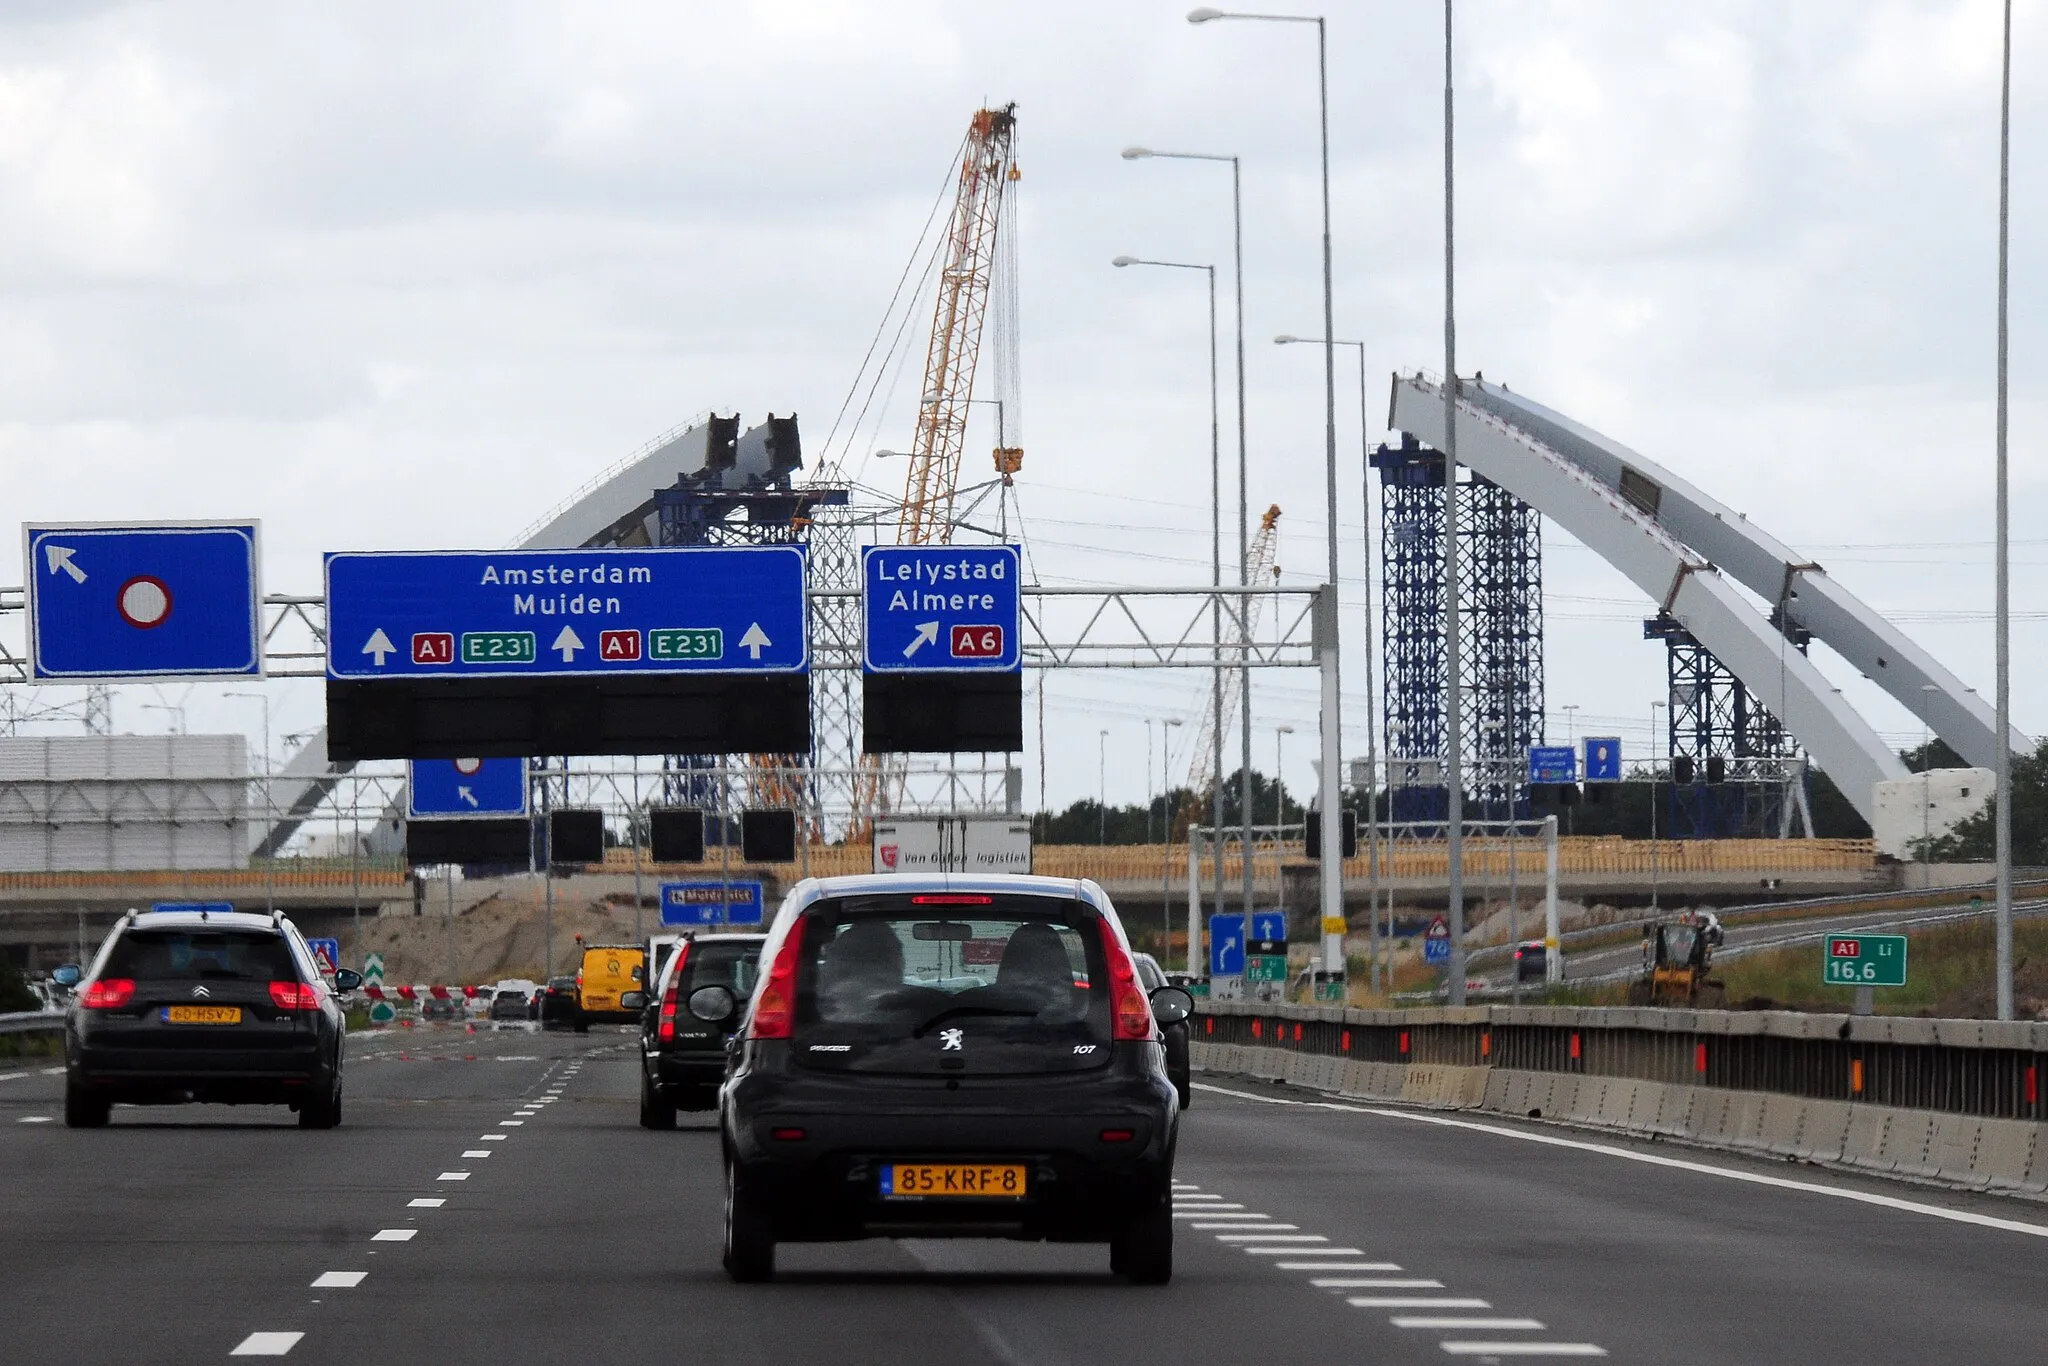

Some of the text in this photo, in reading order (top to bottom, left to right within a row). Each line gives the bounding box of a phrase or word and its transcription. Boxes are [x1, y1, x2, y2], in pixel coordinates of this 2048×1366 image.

[480, 563, 651, 585] Amsterdam
[879, 559, 1005, 586] Lelystad
[514, 593, 621, 615] Muiden
[888, 589, 995, 611] Almere
[419, 638, 530, 657] A1 E231
[606, 635, 717, 654] A1 E231
[958, 631, 996, 651] A6
[904, 852, 926, 864] Van
[976, 851, 1027, 866] logistiek
[1836, 942, 1892, 956] A1 Li
[1830, 961, 1876, 981] 16,6
[1073, 1045, 1096, 1054] 107
[902, 1168, 1017, 1190] 85-KRF-8
